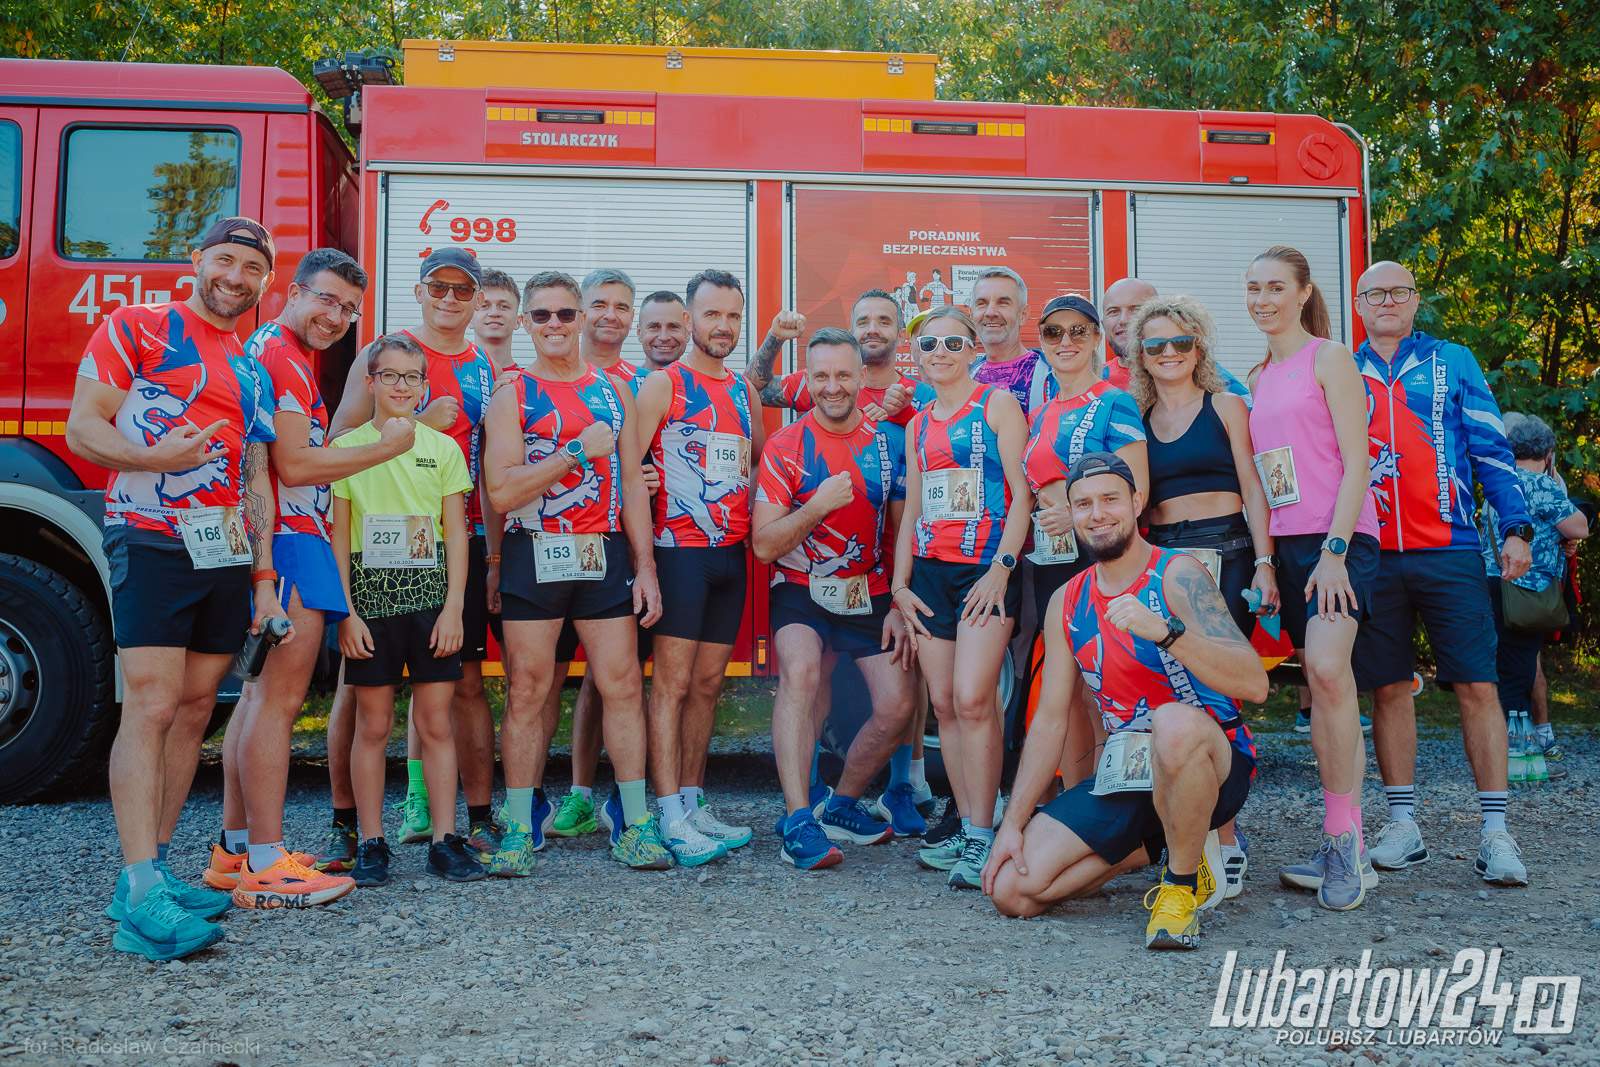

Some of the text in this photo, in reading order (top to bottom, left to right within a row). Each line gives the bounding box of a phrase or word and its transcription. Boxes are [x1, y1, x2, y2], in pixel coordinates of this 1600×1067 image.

[522, 131, 619, 147] STOLARCZYK
[450, 217, 517, 243] 998
[909, 230, 981, 242] PORADNIK
[882, 243, 1008, 257] BEZPIECZEŃSTWA
[68, 274, 142, 324] 451
[714, 448, 736, 461] 156
[927, 486, 944, 500] 185
[194, 526, 221, 542] 168
[372, 531, 401, 545] 237
[544, 545, 571, 560] 153
[822, 585, 837, 597] 72
[1105, 753, 1112, 768] 2
[255, 893, 311, 909] ROME
